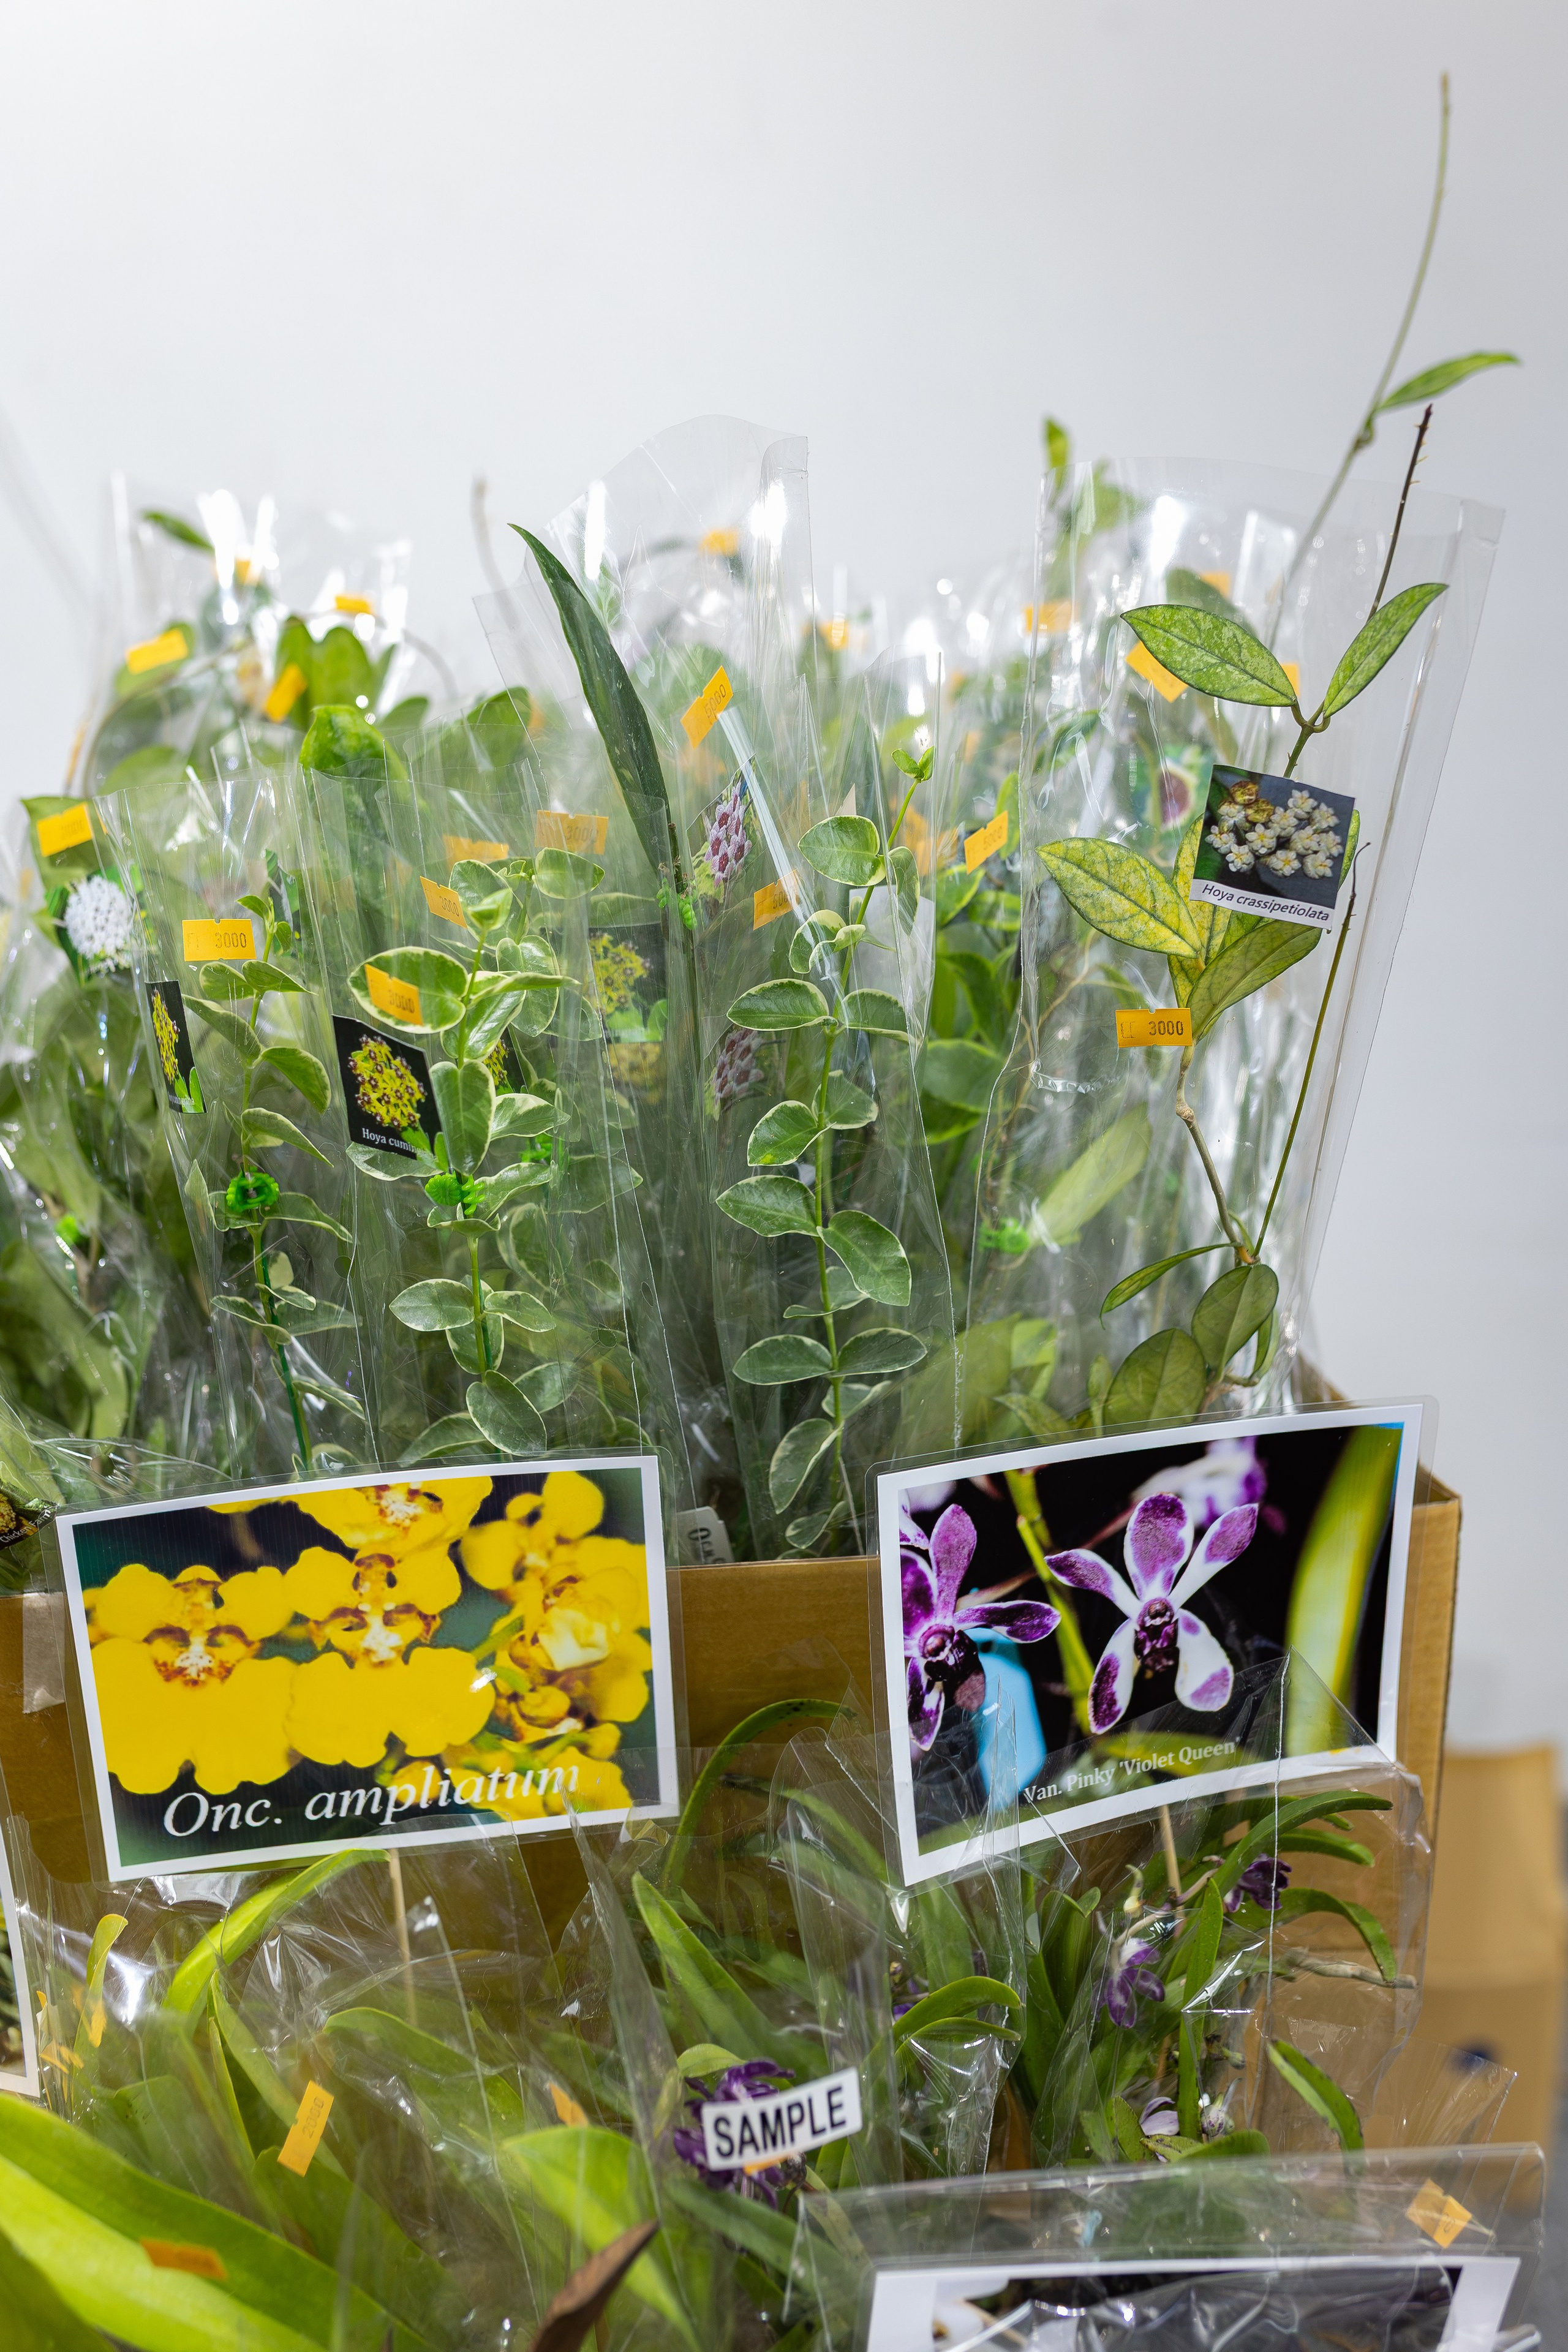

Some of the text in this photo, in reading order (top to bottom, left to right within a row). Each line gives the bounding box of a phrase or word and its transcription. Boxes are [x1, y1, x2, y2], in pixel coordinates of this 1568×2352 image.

[439, 895, 459, 917] 3000
[1202, 884, 1329, 921] Hoya crassipetiolata
[214, 932, 247, 949] 3000
[1148, 1020, 1184, 1036] 3000
[362, 1128, 386, 1144] Hoya
[0, 1526, 32, 1543] Chicken
[1023, 1784, 1062, 1802] Van.
[1067, 1767, 1115, 1792] Pinky
[1119, 1752, 1175, 1776] 'Violet
[164, 1765, 579, 1837] Onc. ampliatum
[714, 2086, 846, 2157] SAMPLE
